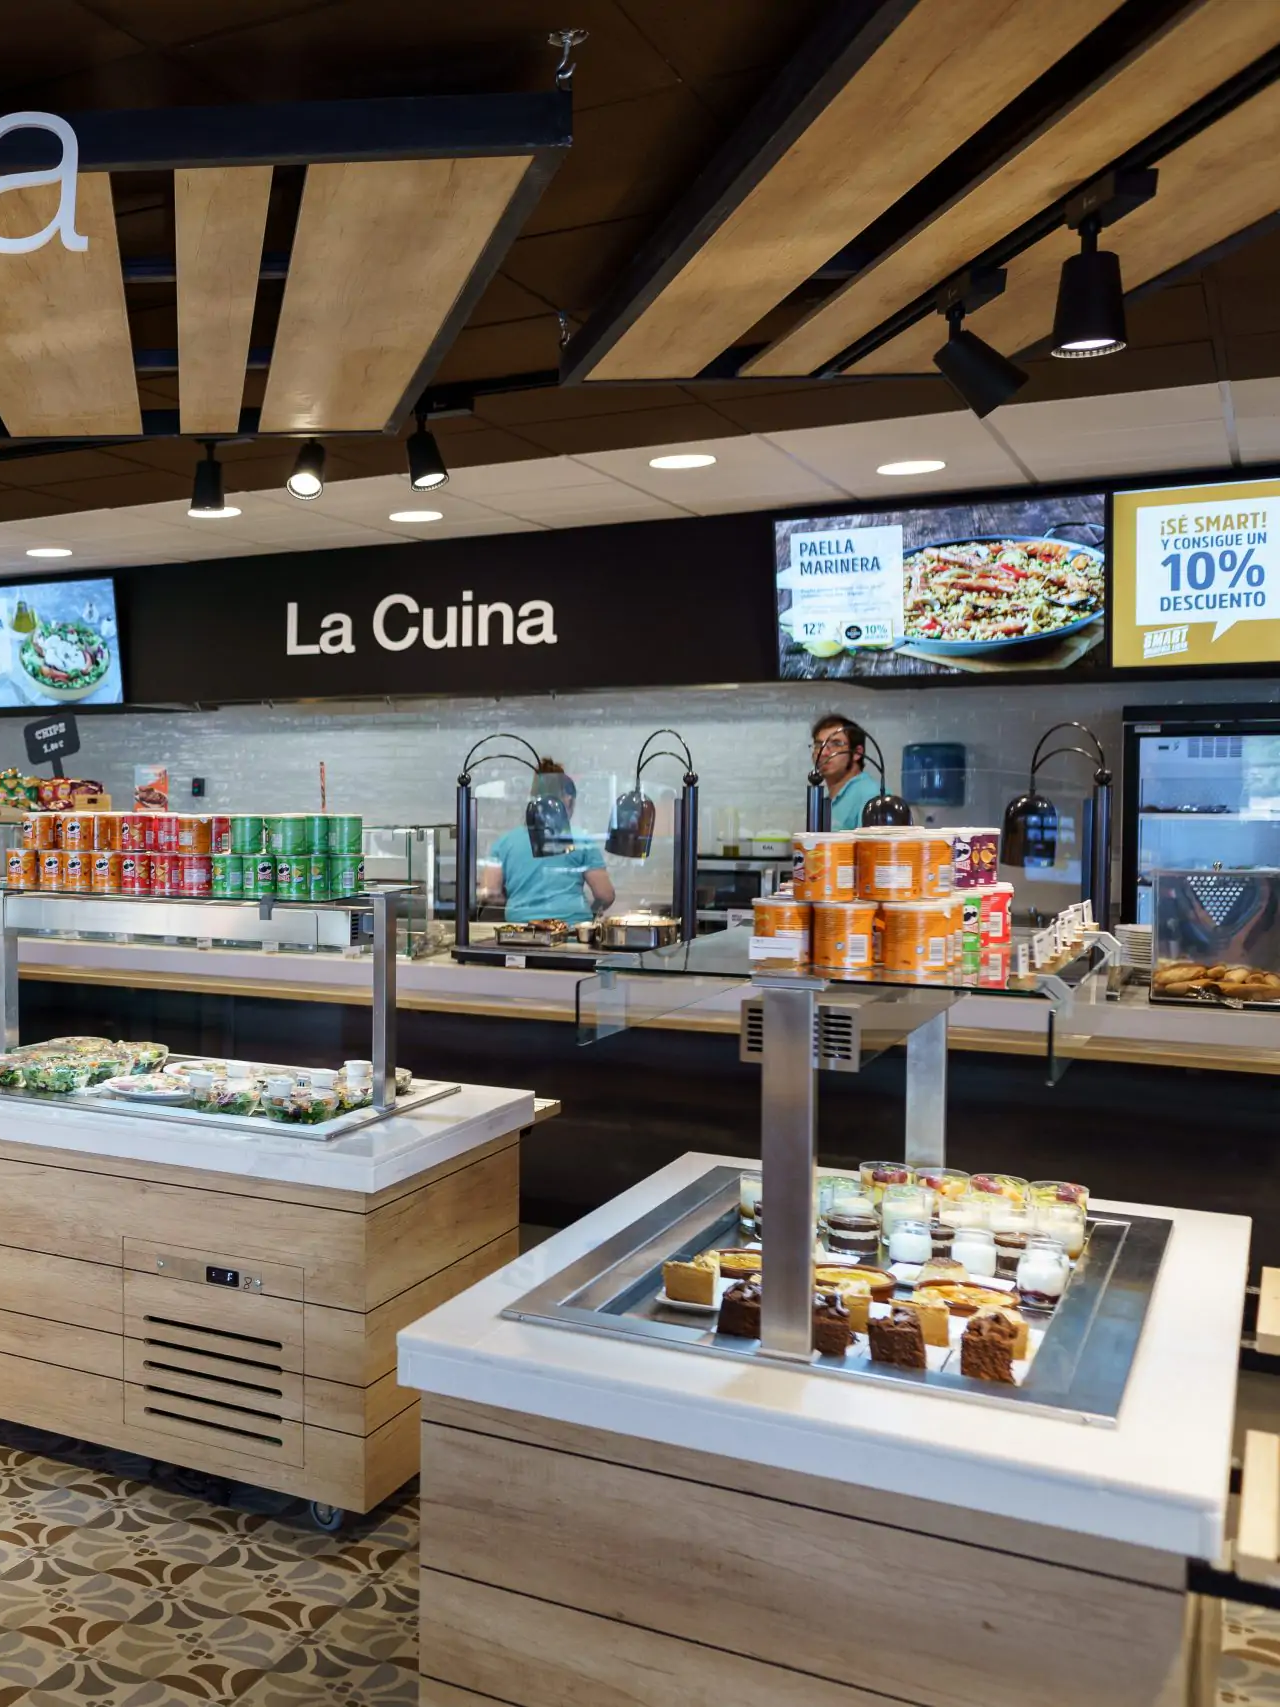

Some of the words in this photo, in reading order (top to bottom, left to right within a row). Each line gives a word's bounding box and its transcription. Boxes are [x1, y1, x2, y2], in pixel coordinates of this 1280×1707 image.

[1160, 515, 1188, 535] ¡SÉ
[1194, 511, 1267, 533] SMART!
[799, 539, 854, 557] PAELLA
[1161, 539, 1170, 550] Y
[1173, 534, 1243, 550] CONSIGUE
[1247, 532, 1267, 545] UN
[800, 556, 881, 576] MARINERA
[1160, 548, 1265, 592] 10%
[1159, 591, 1266, 612] DESCUENTO
[286, 602, 356, 656] La
[372, 590, 558, 652] Cuina
[35, 722, 66, 740] CHIPS
